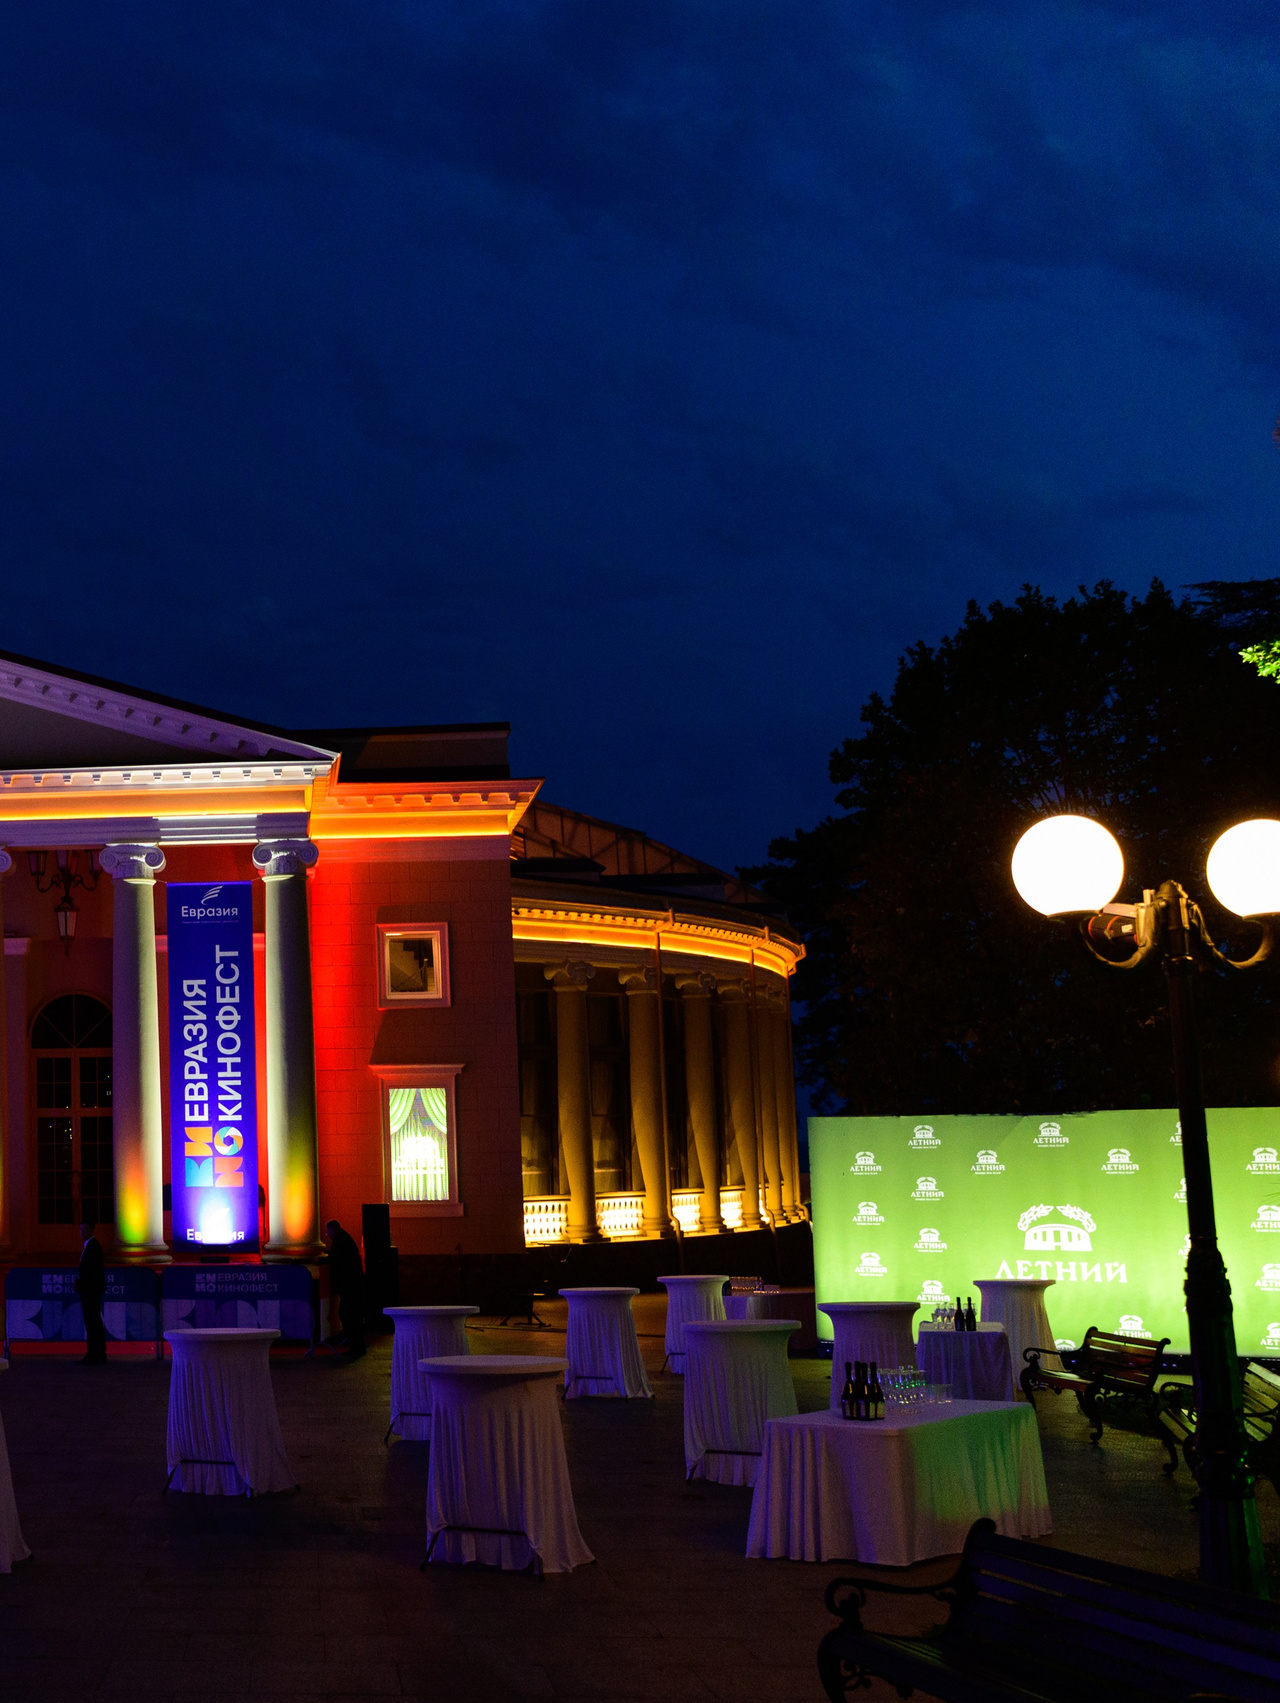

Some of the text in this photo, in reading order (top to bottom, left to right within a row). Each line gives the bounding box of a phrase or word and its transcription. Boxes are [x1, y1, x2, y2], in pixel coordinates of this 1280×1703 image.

[182, 906, 238, 920] Евразия
[215, 945, 242, 1122] КИНОФЕСТ
[182, 979, 209, 1122] ЕВРАЗИЯ
[1033, 1136, 1069, 1144] ЛЕТНИЙ
[850, 1164, 882, 1172] ЛЕТНИЙ
[914, 1242, 947, 1250] ЛЕТНИЙ
[855, 1266, 888, 1274] ЛЕТНИЙ
[995, 1260, 1128, 1283] ЛЕТНИЙ
[218, 1272, 267, 1282] ЕВРАЗИЯ
[218, 1284, 278, 1293] КИНОФЕСТ
